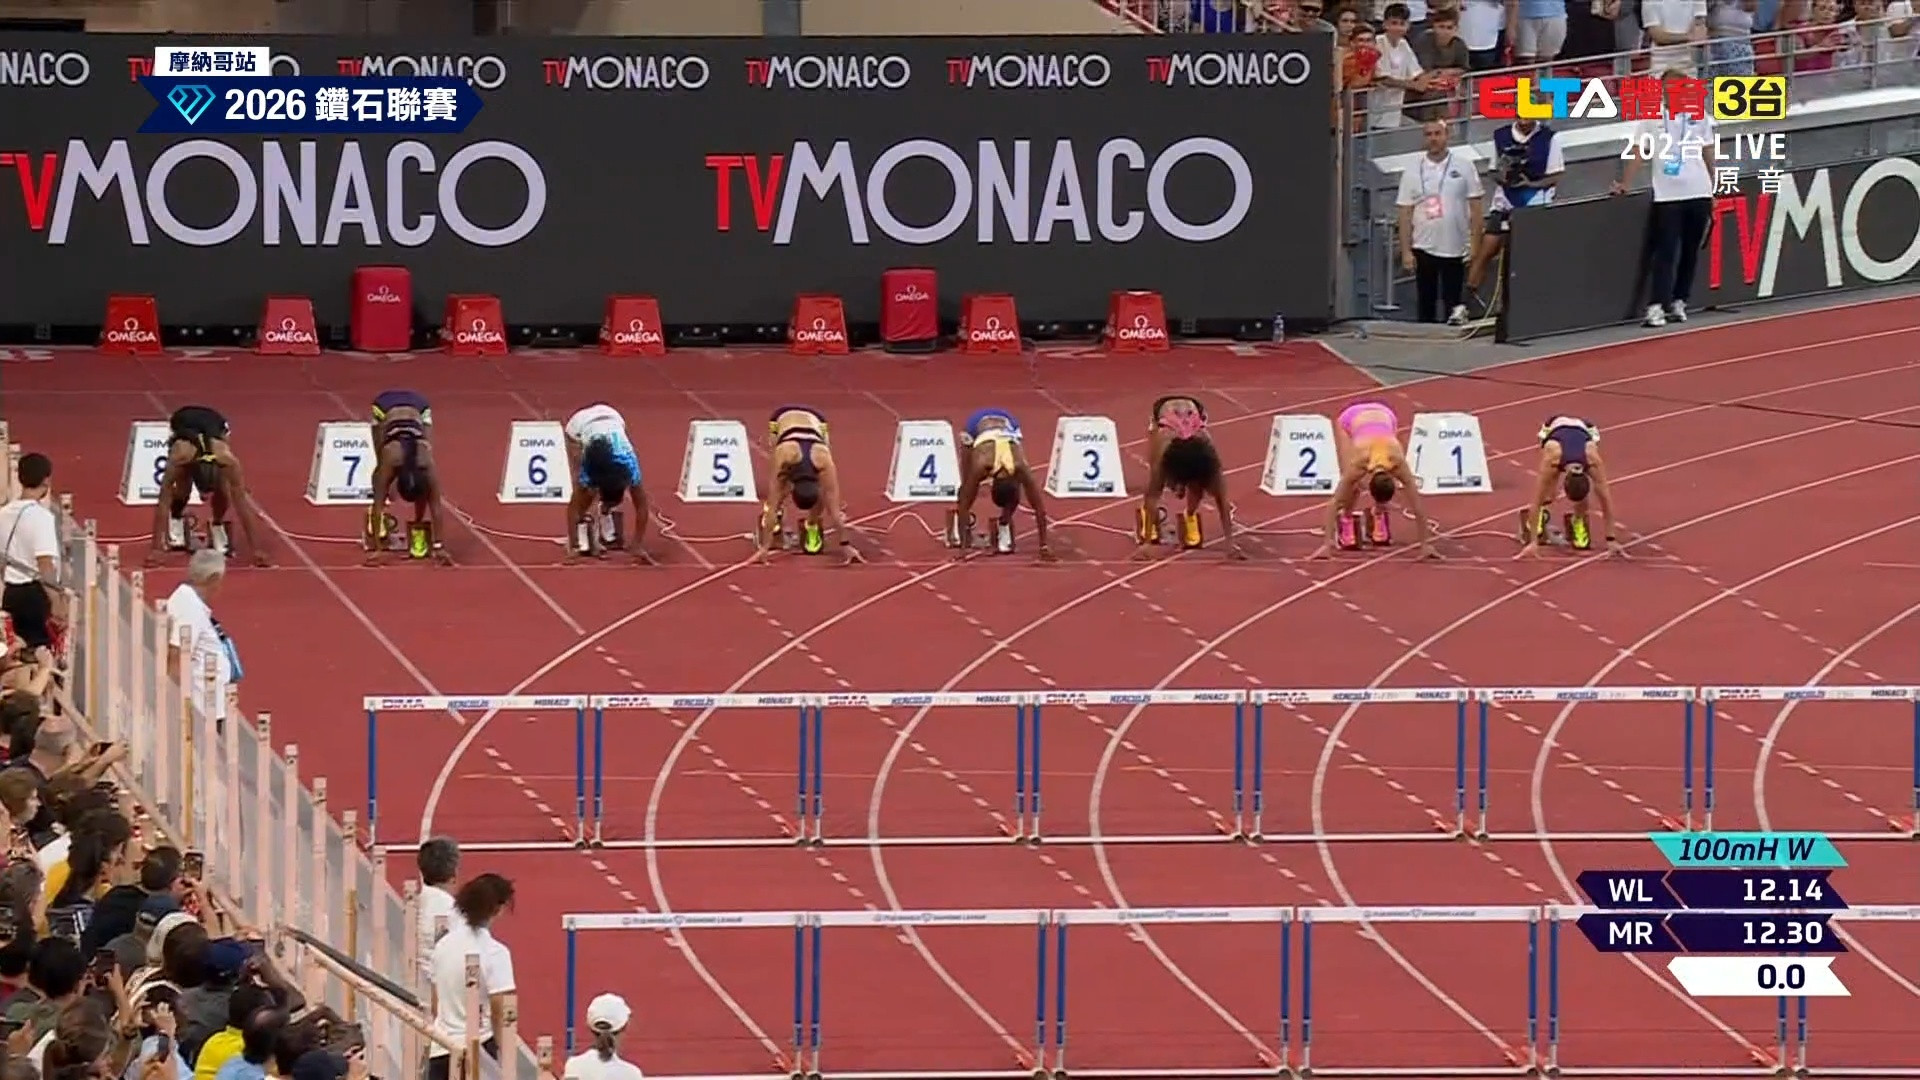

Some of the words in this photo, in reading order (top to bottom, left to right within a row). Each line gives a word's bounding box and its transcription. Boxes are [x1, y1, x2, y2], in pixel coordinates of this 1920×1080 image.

[0, 139, 546, 245] VMONACO
[705, 137, 1253, 244] TVMONACO
[108, 331, 156, 342] OMEGA
[266, 331, 313, 343] OMEGA
[457, 332, 503, 343] OMEGA
[615, 333, 661, 343] OMEGA
[797, 331, 844, 341] OMEGA
[971, 331, 1015, 341] OMEGA
[1119, 329, 1165, 340] OMEGA
[1073, 434, 1108, 443] DIMA
[1289, 432, 1324, 440] DIMA
[1438, 431, 1472, 439] DIMA
[143, 439, 170, 449] DIM
[333, 439, 369, 449] DIMA
[519, 439, 555, 448] DIMA
[702, 438, 738, 446] DIMA
[910, 438, 944, 446] DIMA
[1083, 450, 1100, 480] 3
[1299, 447, 1317, 477] 2
[1451, 446, 1462, 477] 1
[342, 456, 360, 486] 7
[528, 455, 547, 485] 6
[712, 453, 731, 483] 5
[919, 453, 937, 484] 4
